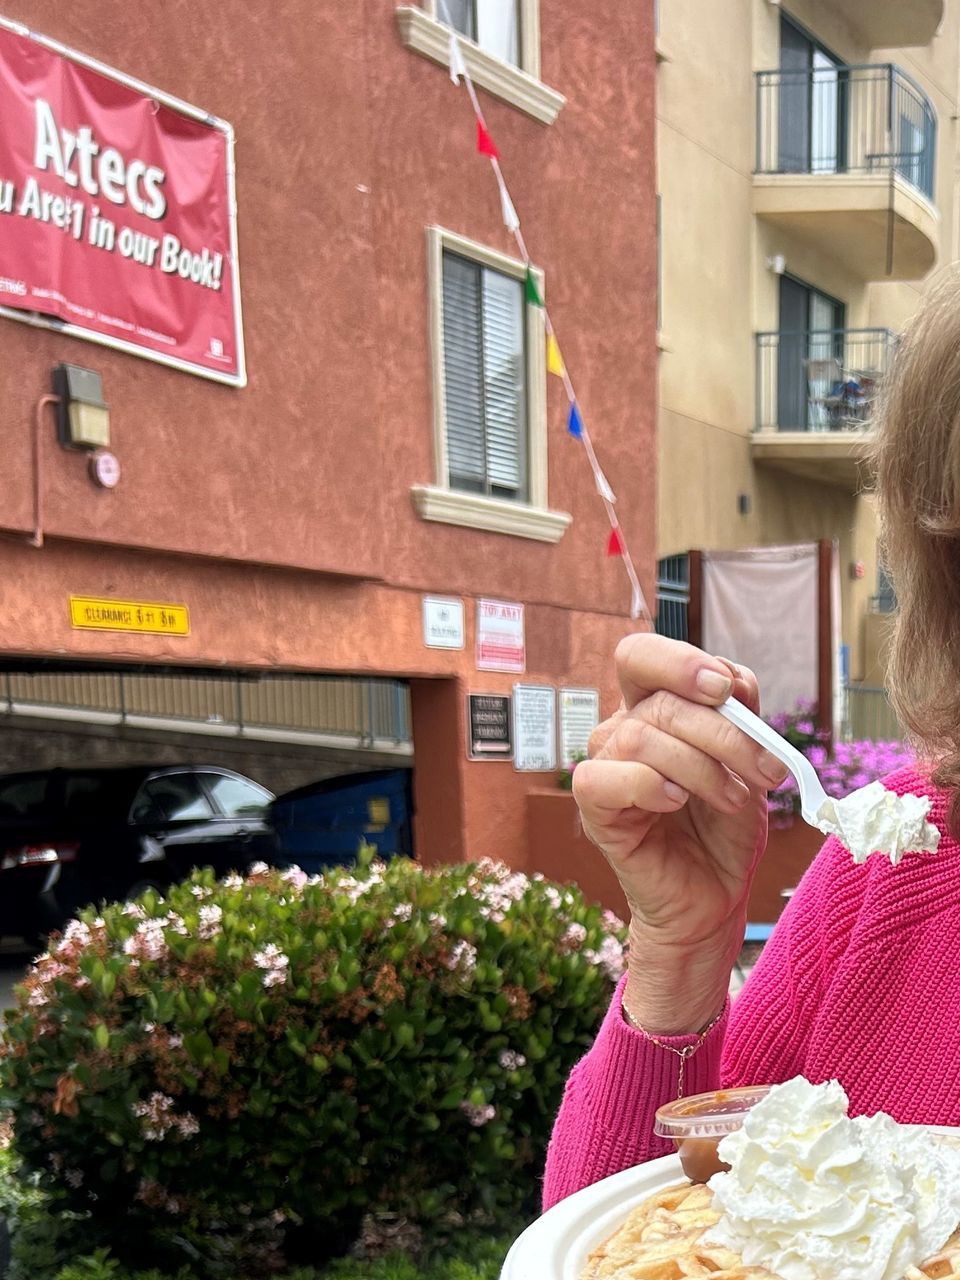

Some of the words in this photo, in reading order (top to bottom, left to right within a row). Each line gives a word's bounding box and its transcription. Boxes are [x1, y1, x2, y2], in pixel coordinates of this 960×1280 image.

[35, 99, 166, 220] Aztecs
[18, 176, 65, 226] Are
[89, 204, 115, 251] in
[118, 227, 159, 266] our
[160, 233, 222, 290] Book!
